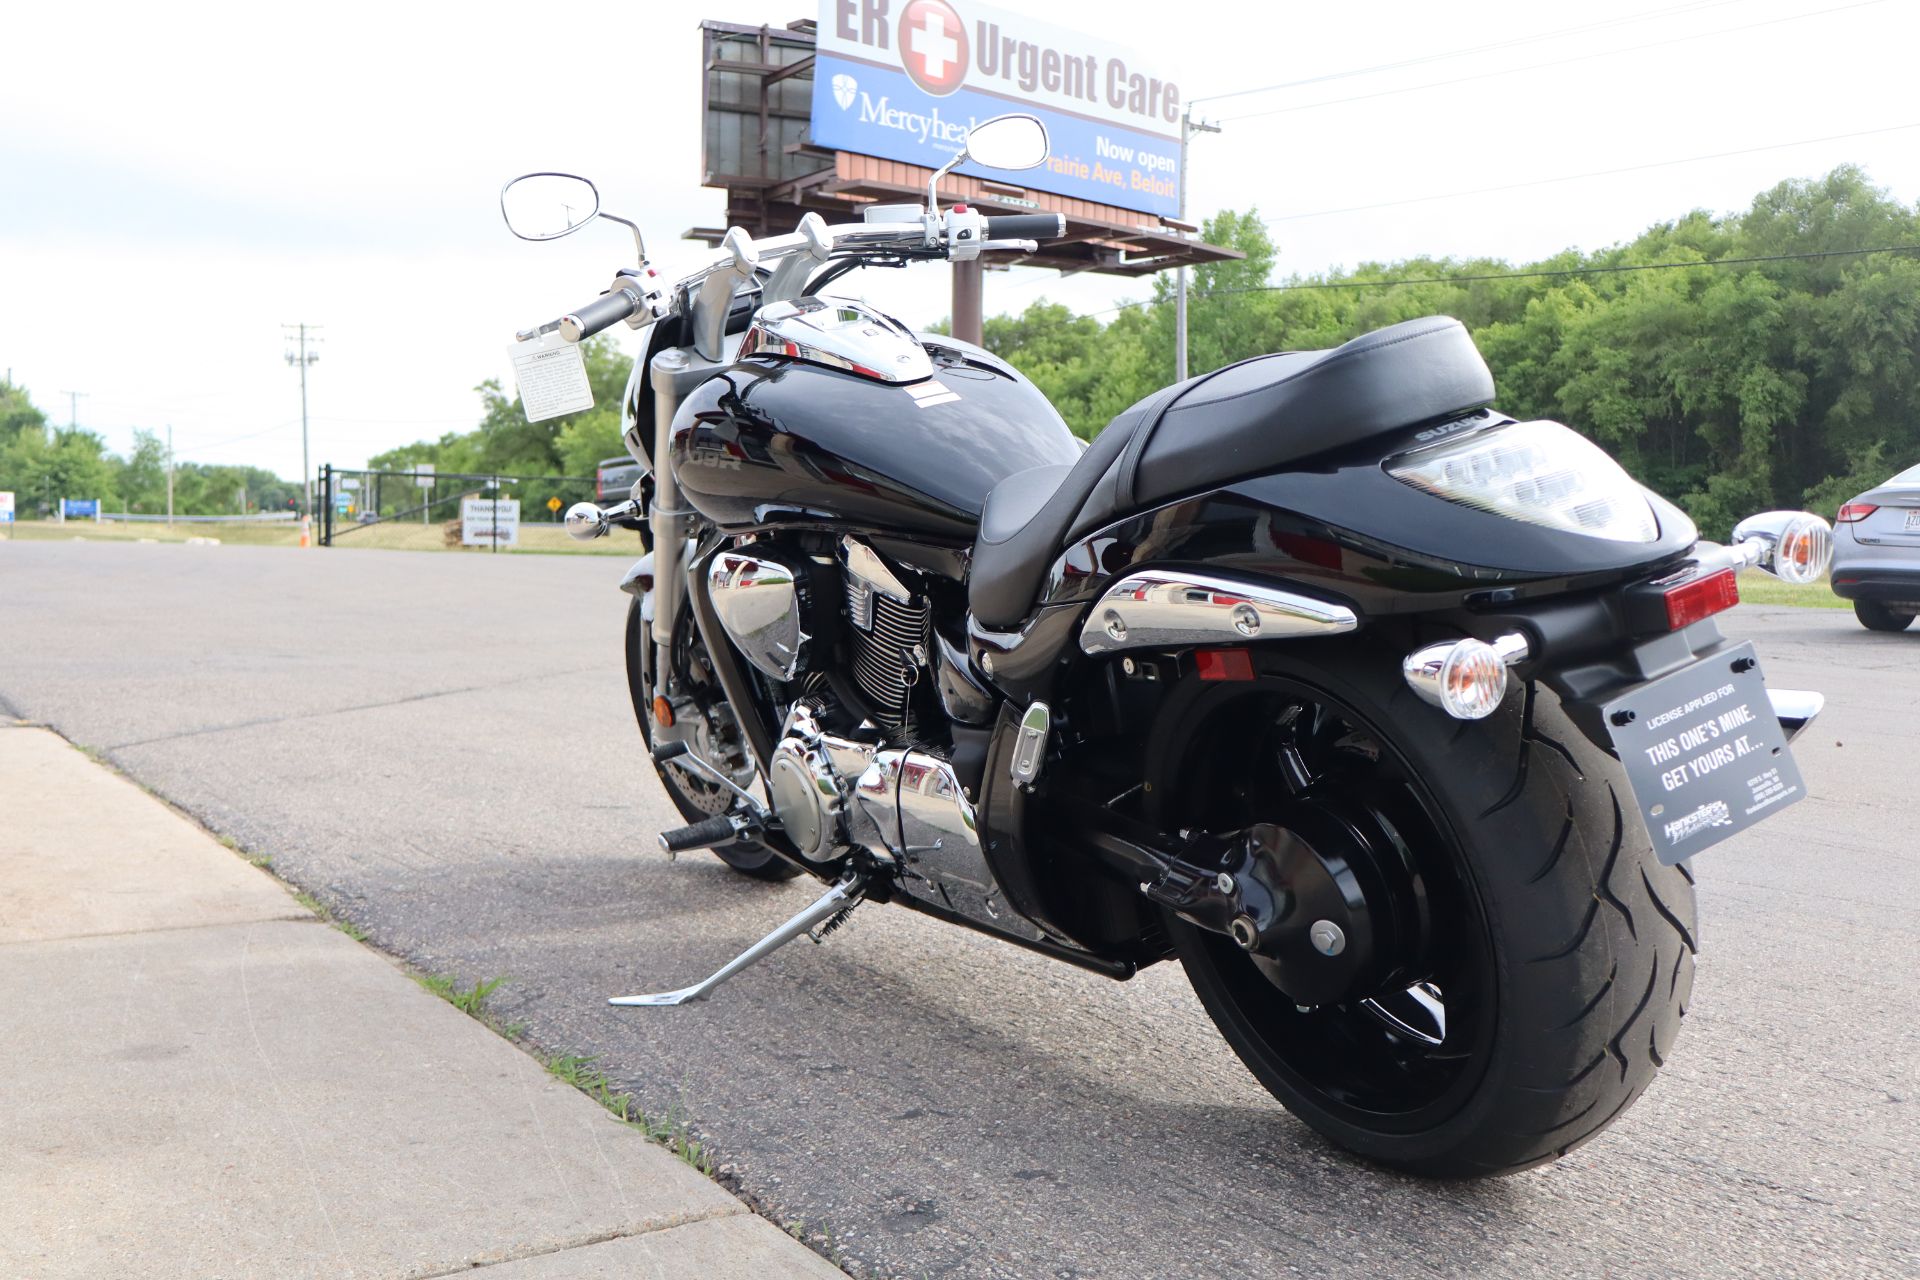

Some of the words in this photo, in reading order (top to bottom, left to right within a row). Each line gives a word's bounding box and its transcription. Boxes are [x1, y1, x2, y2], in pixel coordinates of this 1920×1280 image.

[836, 0, 889, 50] ER
[976, 19, 1098, 103] Urgent
[1106, 57, 1180, 124] Care
[1045, 155, 1090, 180] rairie
[1091, 161, 1127, 190] Ave,
[1130, 169, 1177, 199] Beloit
[1096, 135, 1135, 163] Now
[1138, 151, 1176, 173] open
[1646, 706, 1685, 731] LICENSE
[1684, 691, 1718, 714] APPLIED
[1717, 683, 1735, 698] FOR
[1645, 738, 1680, 766] THIS
[1679, 719, 1719, 751] ONE'S
[1717, 704, 1756, 733] MINE.
[1661, 764, 1689, 792] GET
[1688, 743, 1735, 778] YOURS
